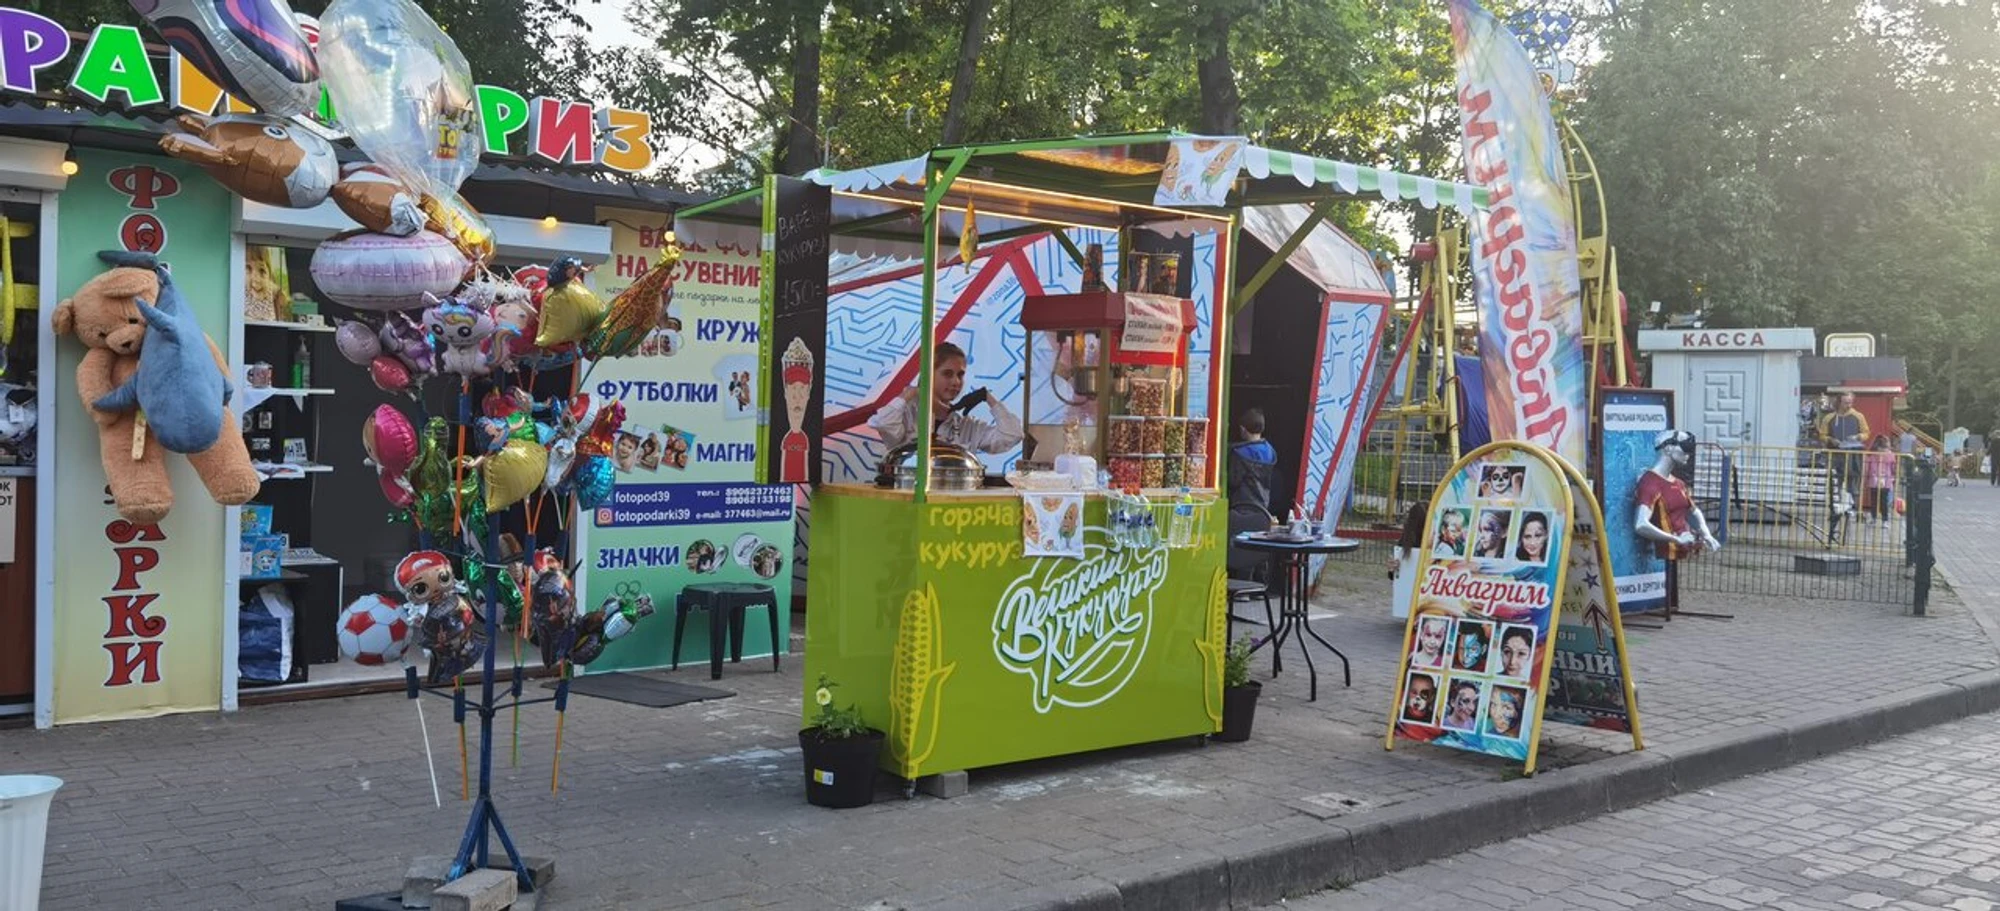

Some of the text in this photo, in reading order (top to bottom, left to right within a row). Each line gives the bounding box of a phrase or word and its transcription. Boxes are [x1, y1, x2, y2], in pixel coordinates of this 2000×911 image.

[616, 254, 761, 287] НА СУВЕНИР
[1683, 332, 1765, 347] КАССА
[596, 380, 718, 403] ФУТБОЛКИ
[615, 490, 670, 504] fotopod39
[615, 507, 691, 522] fotopodarki39
[929, 504, 1022, 535] горяча
[596, 545, 680, 569] ЗНАЧКИ
[1421, 567, 1547, 615] Аквагрим
